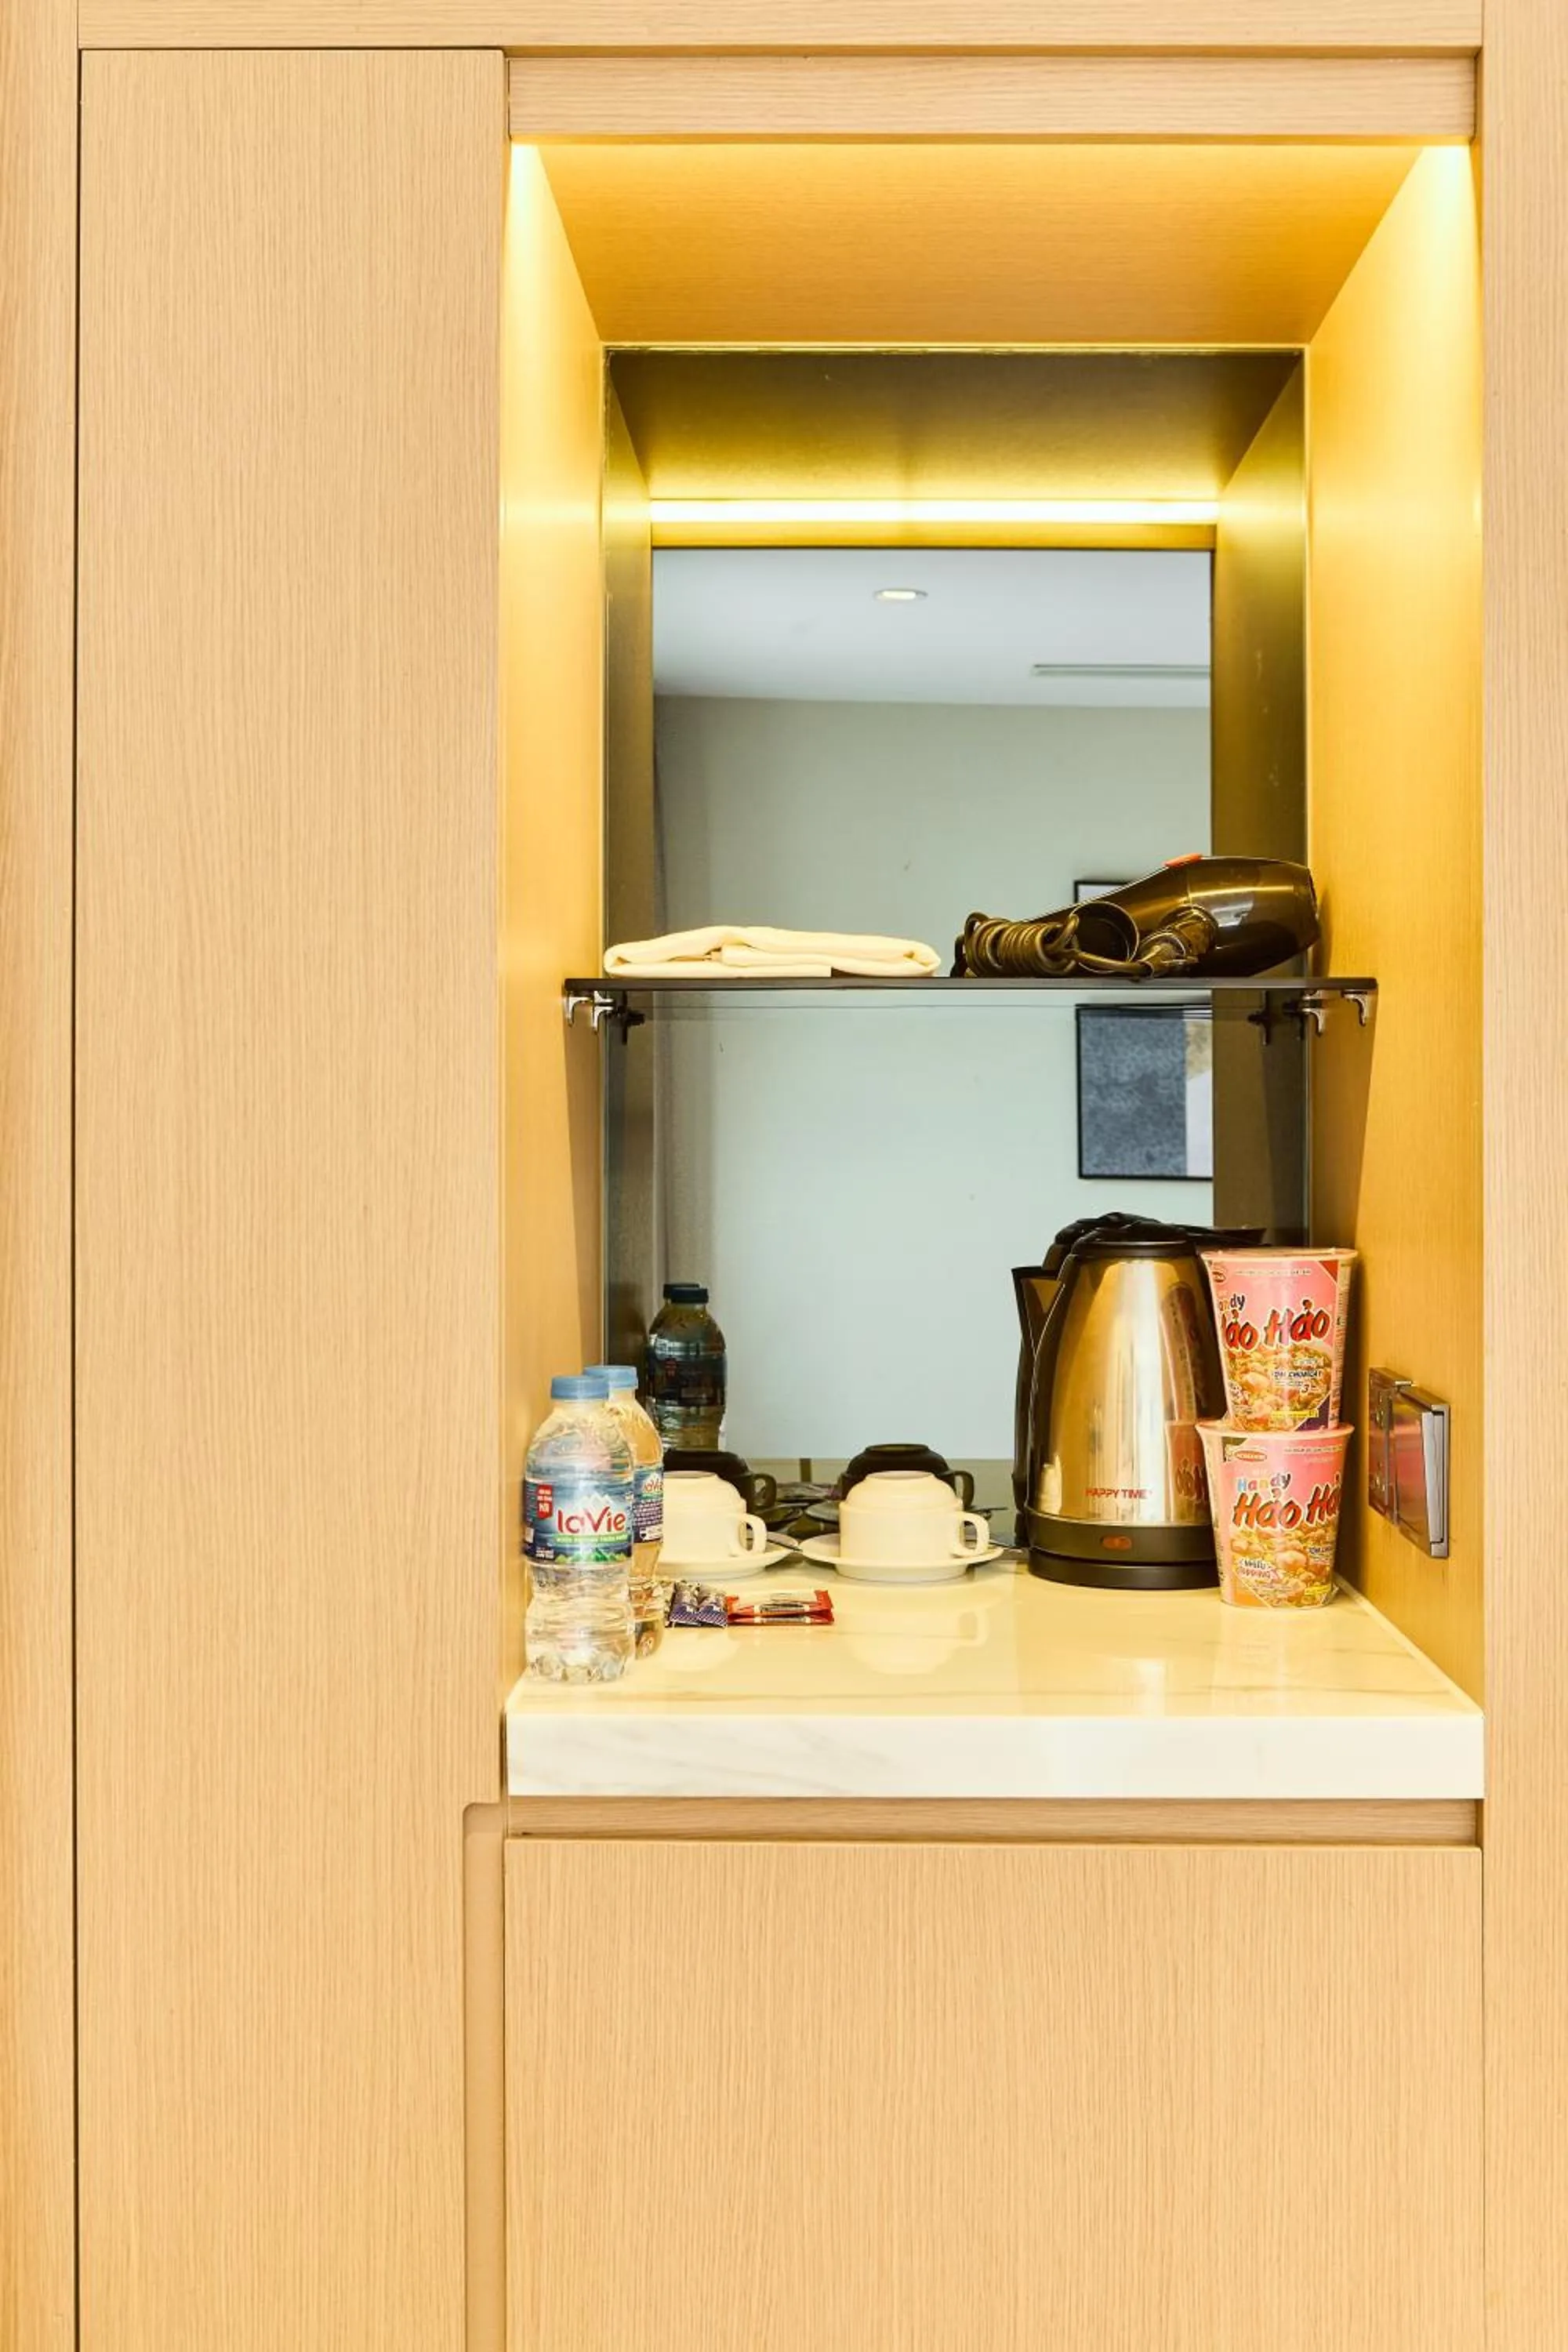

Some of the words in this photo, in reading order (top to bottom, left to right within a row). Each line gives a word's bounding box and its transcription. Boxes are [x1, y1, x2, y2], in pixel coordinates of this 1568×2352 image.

[1263, 1299, 1330, 1346] Hảo
[1085, 1487, 1120, 1498] HAPPY
[1120, 1488, 1148, 1499] TIME
[1237, 1473, 1291, 1490] Handy
[1232, 1487, 1303, 1529] Hảo
[1306, 1470, 1341, 1525] Hả
[557, 1505, 626, 1534] laVie
